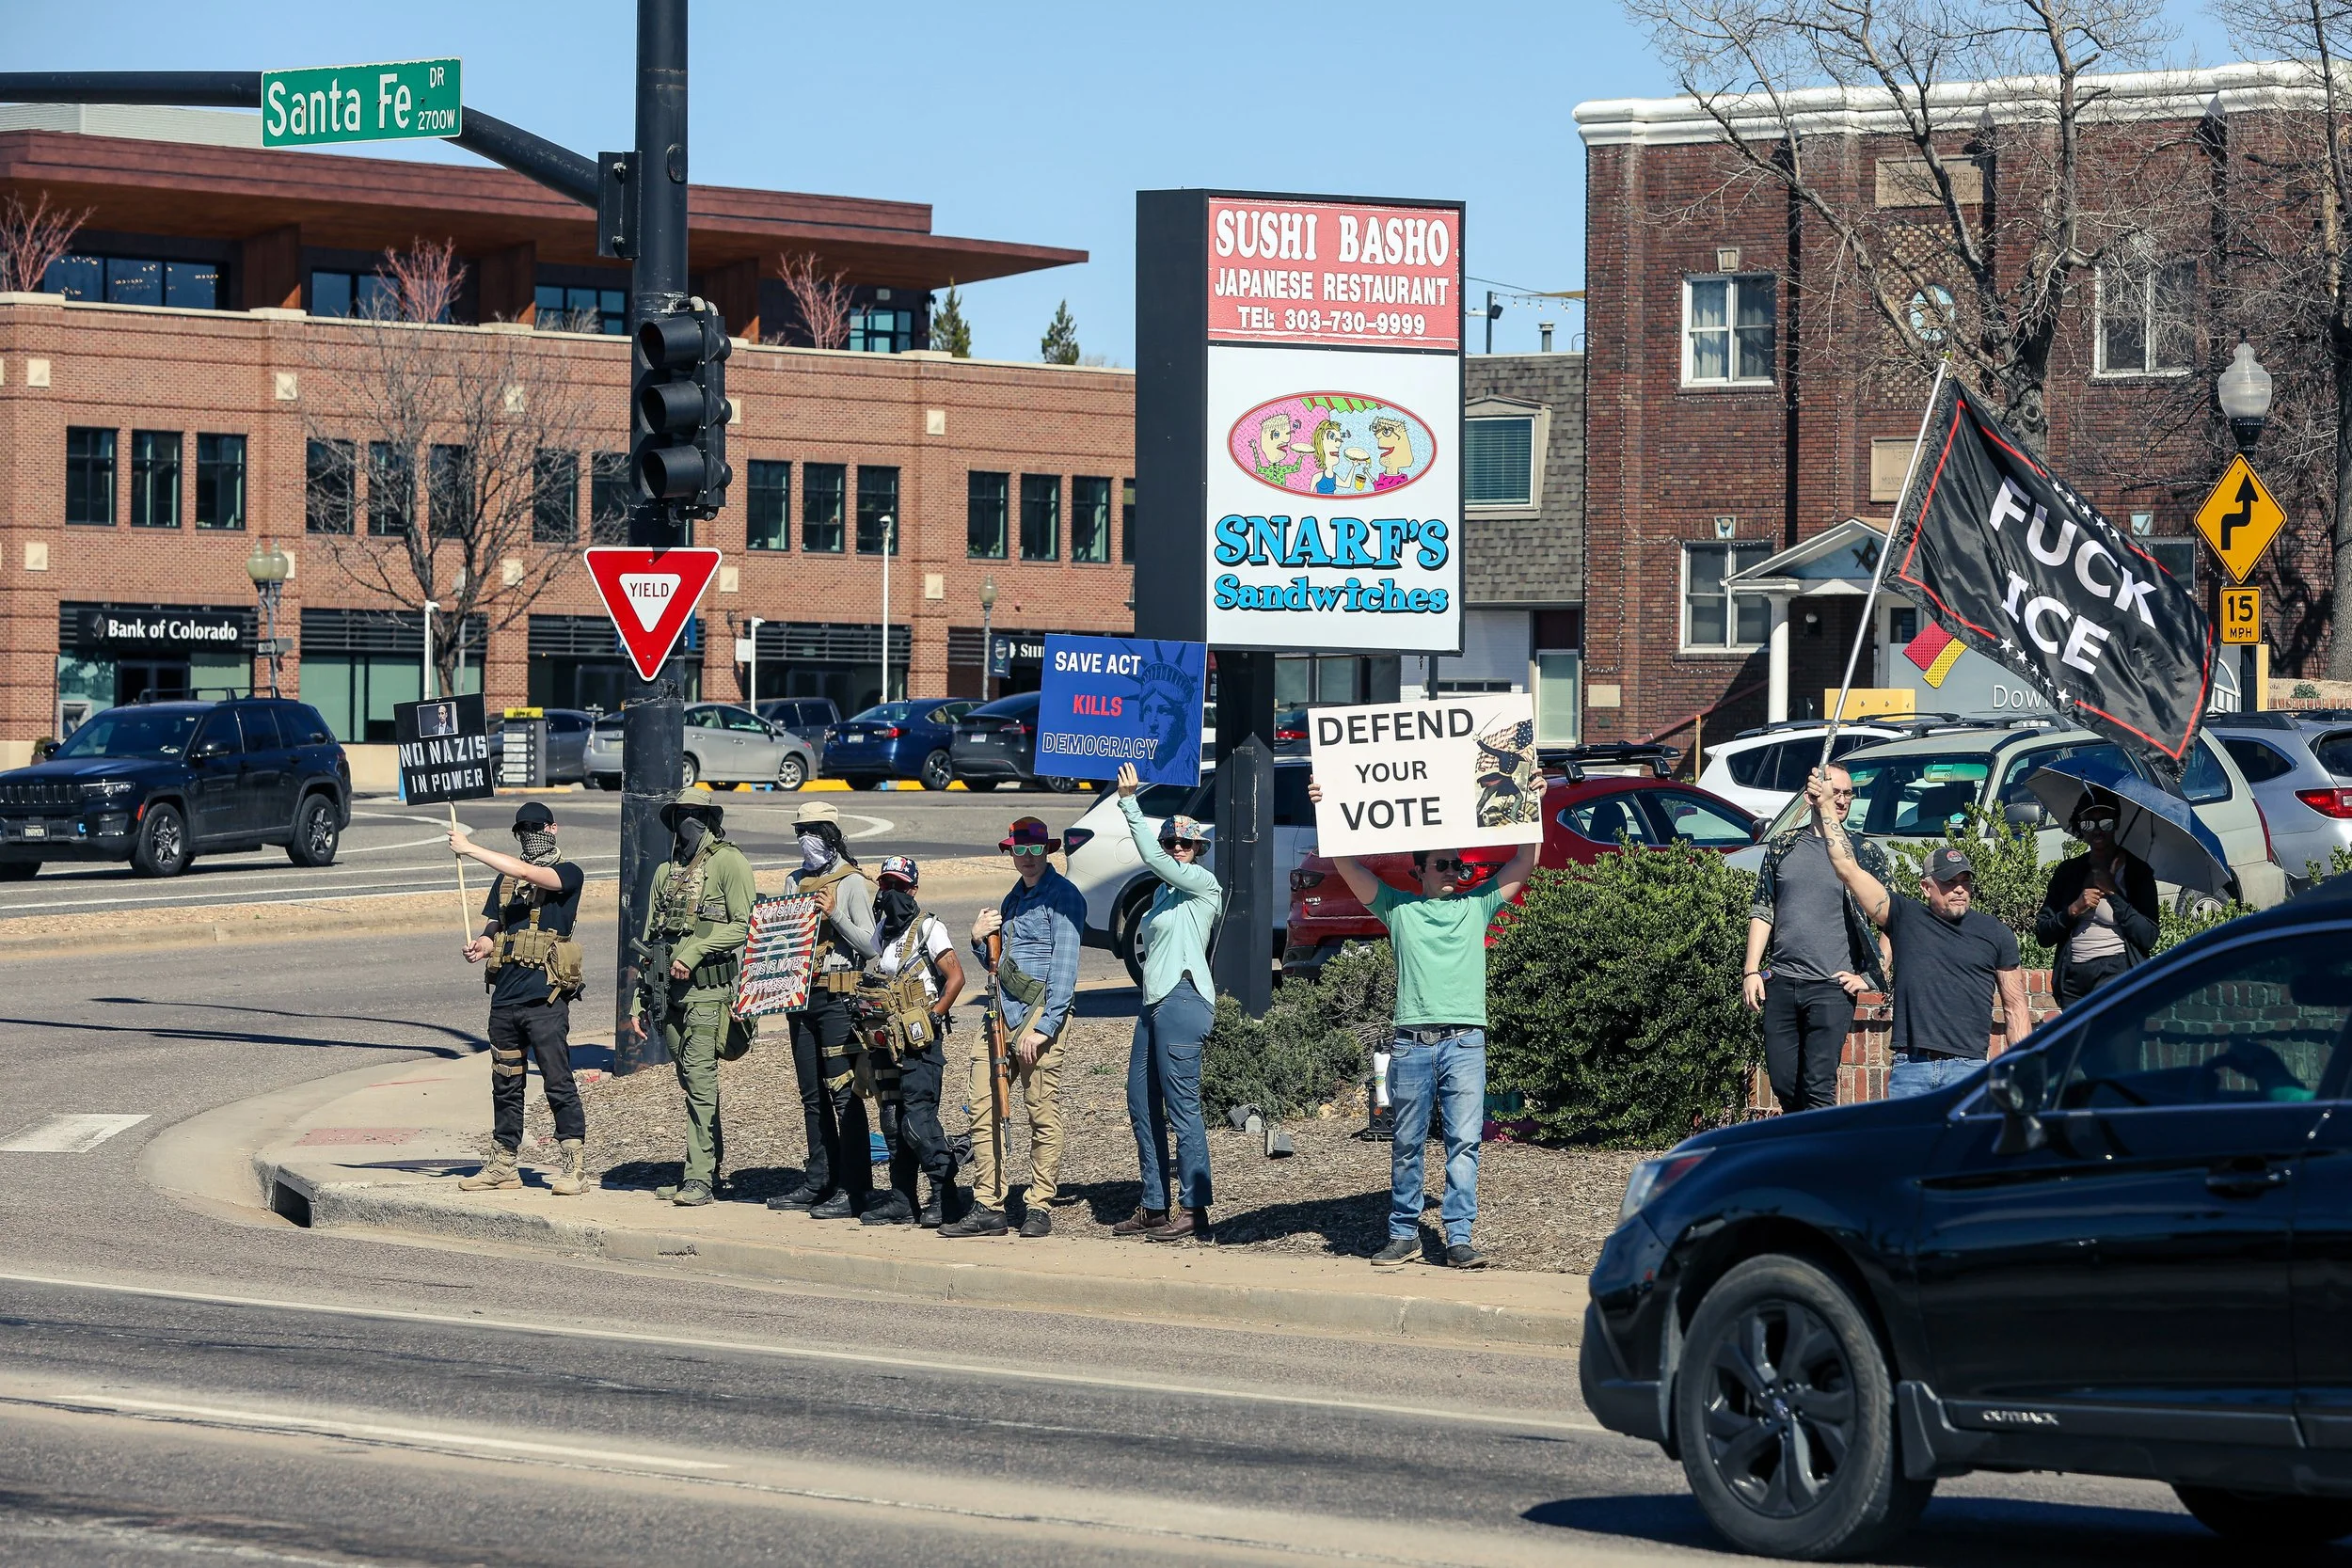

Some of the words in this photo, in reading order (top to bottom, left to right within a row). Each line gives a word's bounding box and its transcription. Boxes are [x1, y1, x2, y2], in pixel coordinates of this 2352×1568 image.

[429, 67, 445, 88] DR
[266, 78, 361, 137] Santa
[378, 72, 412, 130] Fe
[417, 109, 456, 131] 2700W
[1215, 209, 1318, 261] SUSHI
[1338, 214, 1450, 267] BASHO
[1214, 267, 1314, 301] JAPANESE
[1323, 272, 1450, 306] RESTAURANT
[1284, 308, 1426, 336] 303-730-9999
[1215, 514, 1449, 571] SNARF'S
[1989, 475, 2157, 629] FUCK
[629, 582, 670, 597] YIELD
[1215, 574, 1449, 614] Sandwiches
[2001, 569, 2110, 675] ICE
[2227, 595, 2254, 622] 15
[108, 618, 146, 639] Bank
[150, 619, 167, 639] of
[168, 620, 238, 641] Colorado
[2230, 627, 2252, 638] MPH
[1055, 651, 1103, 673] SAVE
[1105, 654, 1142, 675] ACT
[1073, 694, 1123, 717] KILLS
[1317, 708, 1474, 746] DEFEND
[399, 741, 425, 768] NO
[428, 735, 488, 766] NAZIS
[1041, 732, 1159, 760] DEMOCRACY
[411, 773, 428, 794] IN
[431, 768, 485, 793] POWER
[1355, 760, 1428, 784] YOUR
[1340, 797, 1442, 831] VOTE
[753, 904, 778, 921] STOP
[777, 900, 802, 918] SAVE
[747, 960, 767, 977] THIS
[767, 958, 778, 974] IS
[743, 974, 805, 996] SUPPRESSION
